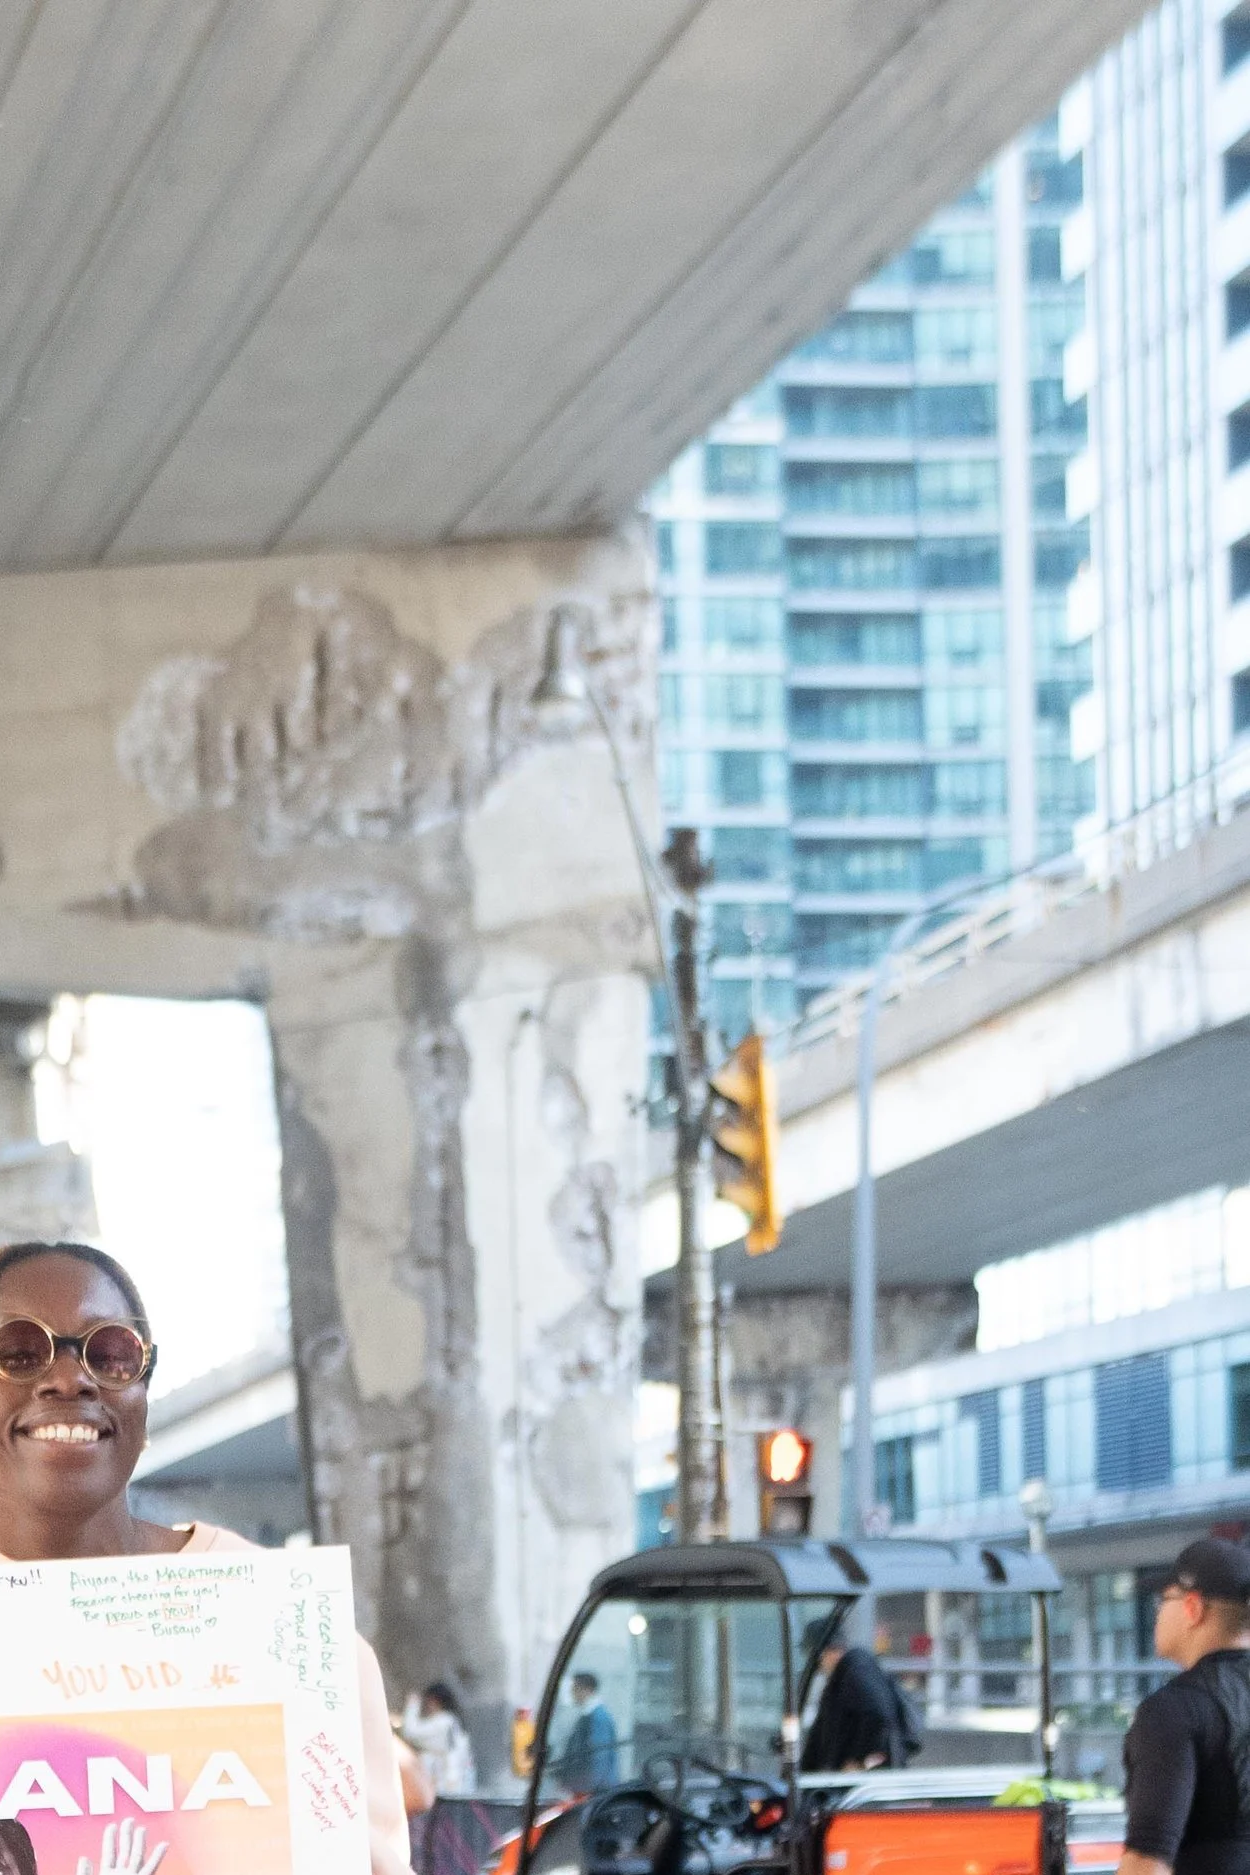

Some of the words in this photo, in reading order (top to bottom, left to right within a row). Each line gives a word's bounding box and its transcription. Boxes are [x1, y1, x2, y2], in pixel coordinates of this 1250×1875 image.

[127, 1570, 150, 1583] the
[42, 1660, 107, 1701] YOU
[120, 1661, 183, 1692] DID
